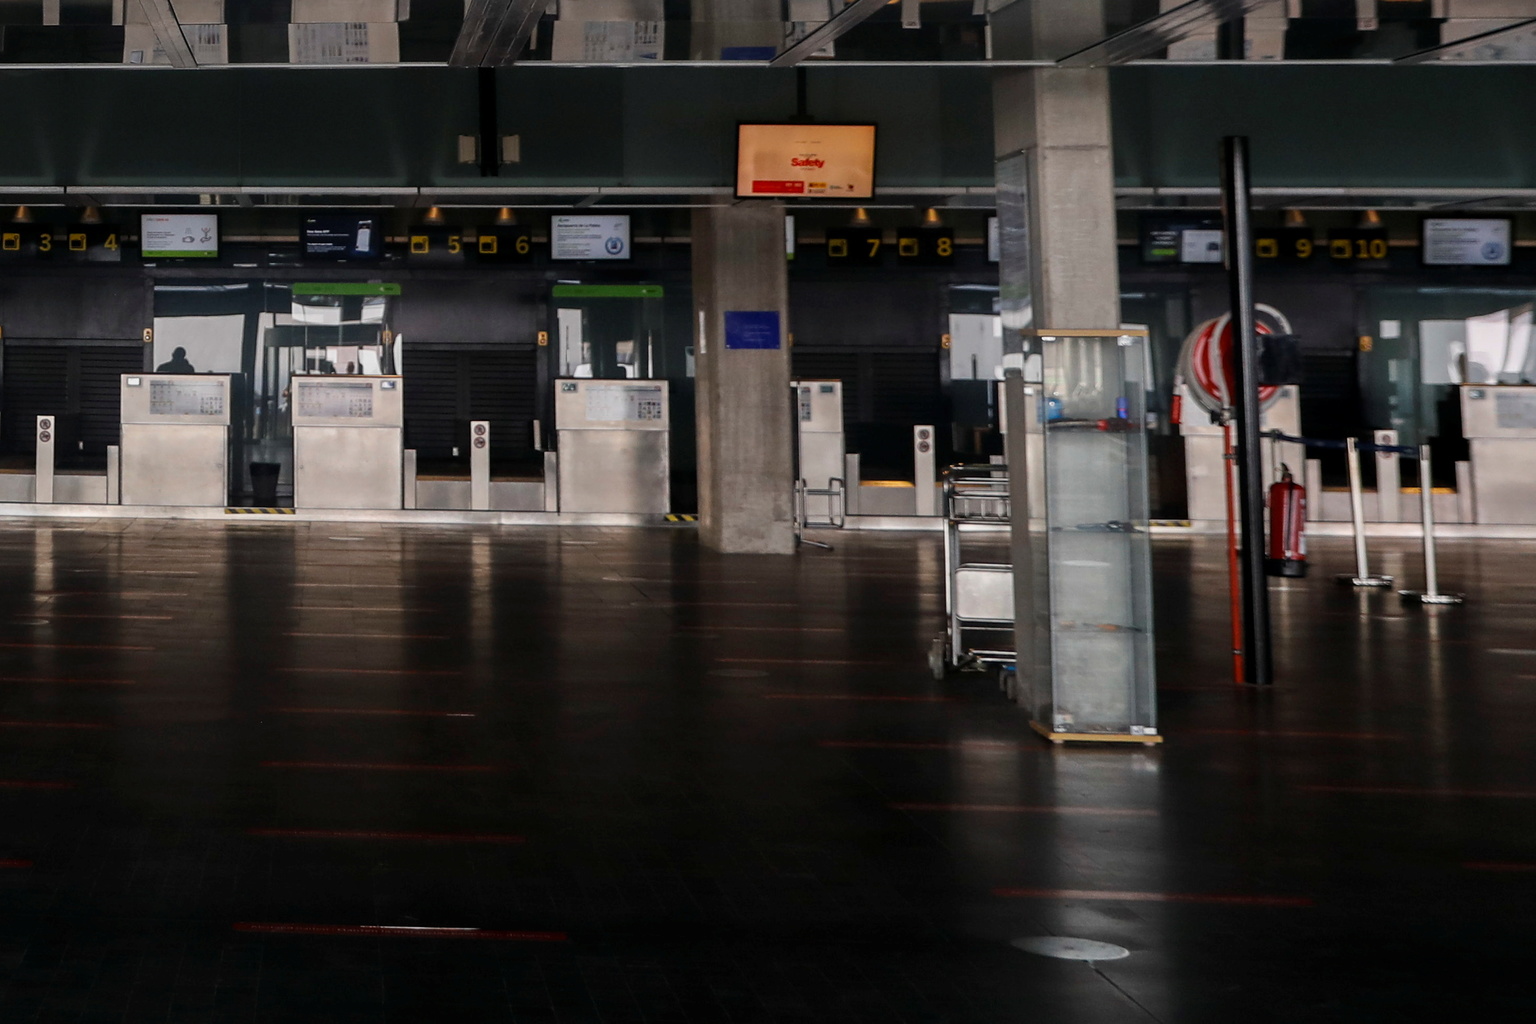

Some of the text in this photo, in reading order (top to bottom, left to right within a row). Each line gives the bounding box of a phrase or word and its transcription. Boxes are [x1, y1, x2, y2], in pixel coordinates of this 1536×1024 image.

[791, 157, 825, 168] Safety
[39, 233, 52, 251] 3
[104, 233, 118, 251] 4
[448, 235, 461, 254] 5
[515, 235, 529, 254] 6
[867, 237, 880, 257] 7
[937, 237, 952, 257] 8
[1295, 237, 1312, 258] 9
[1356, 237, 1387, 258] 10
